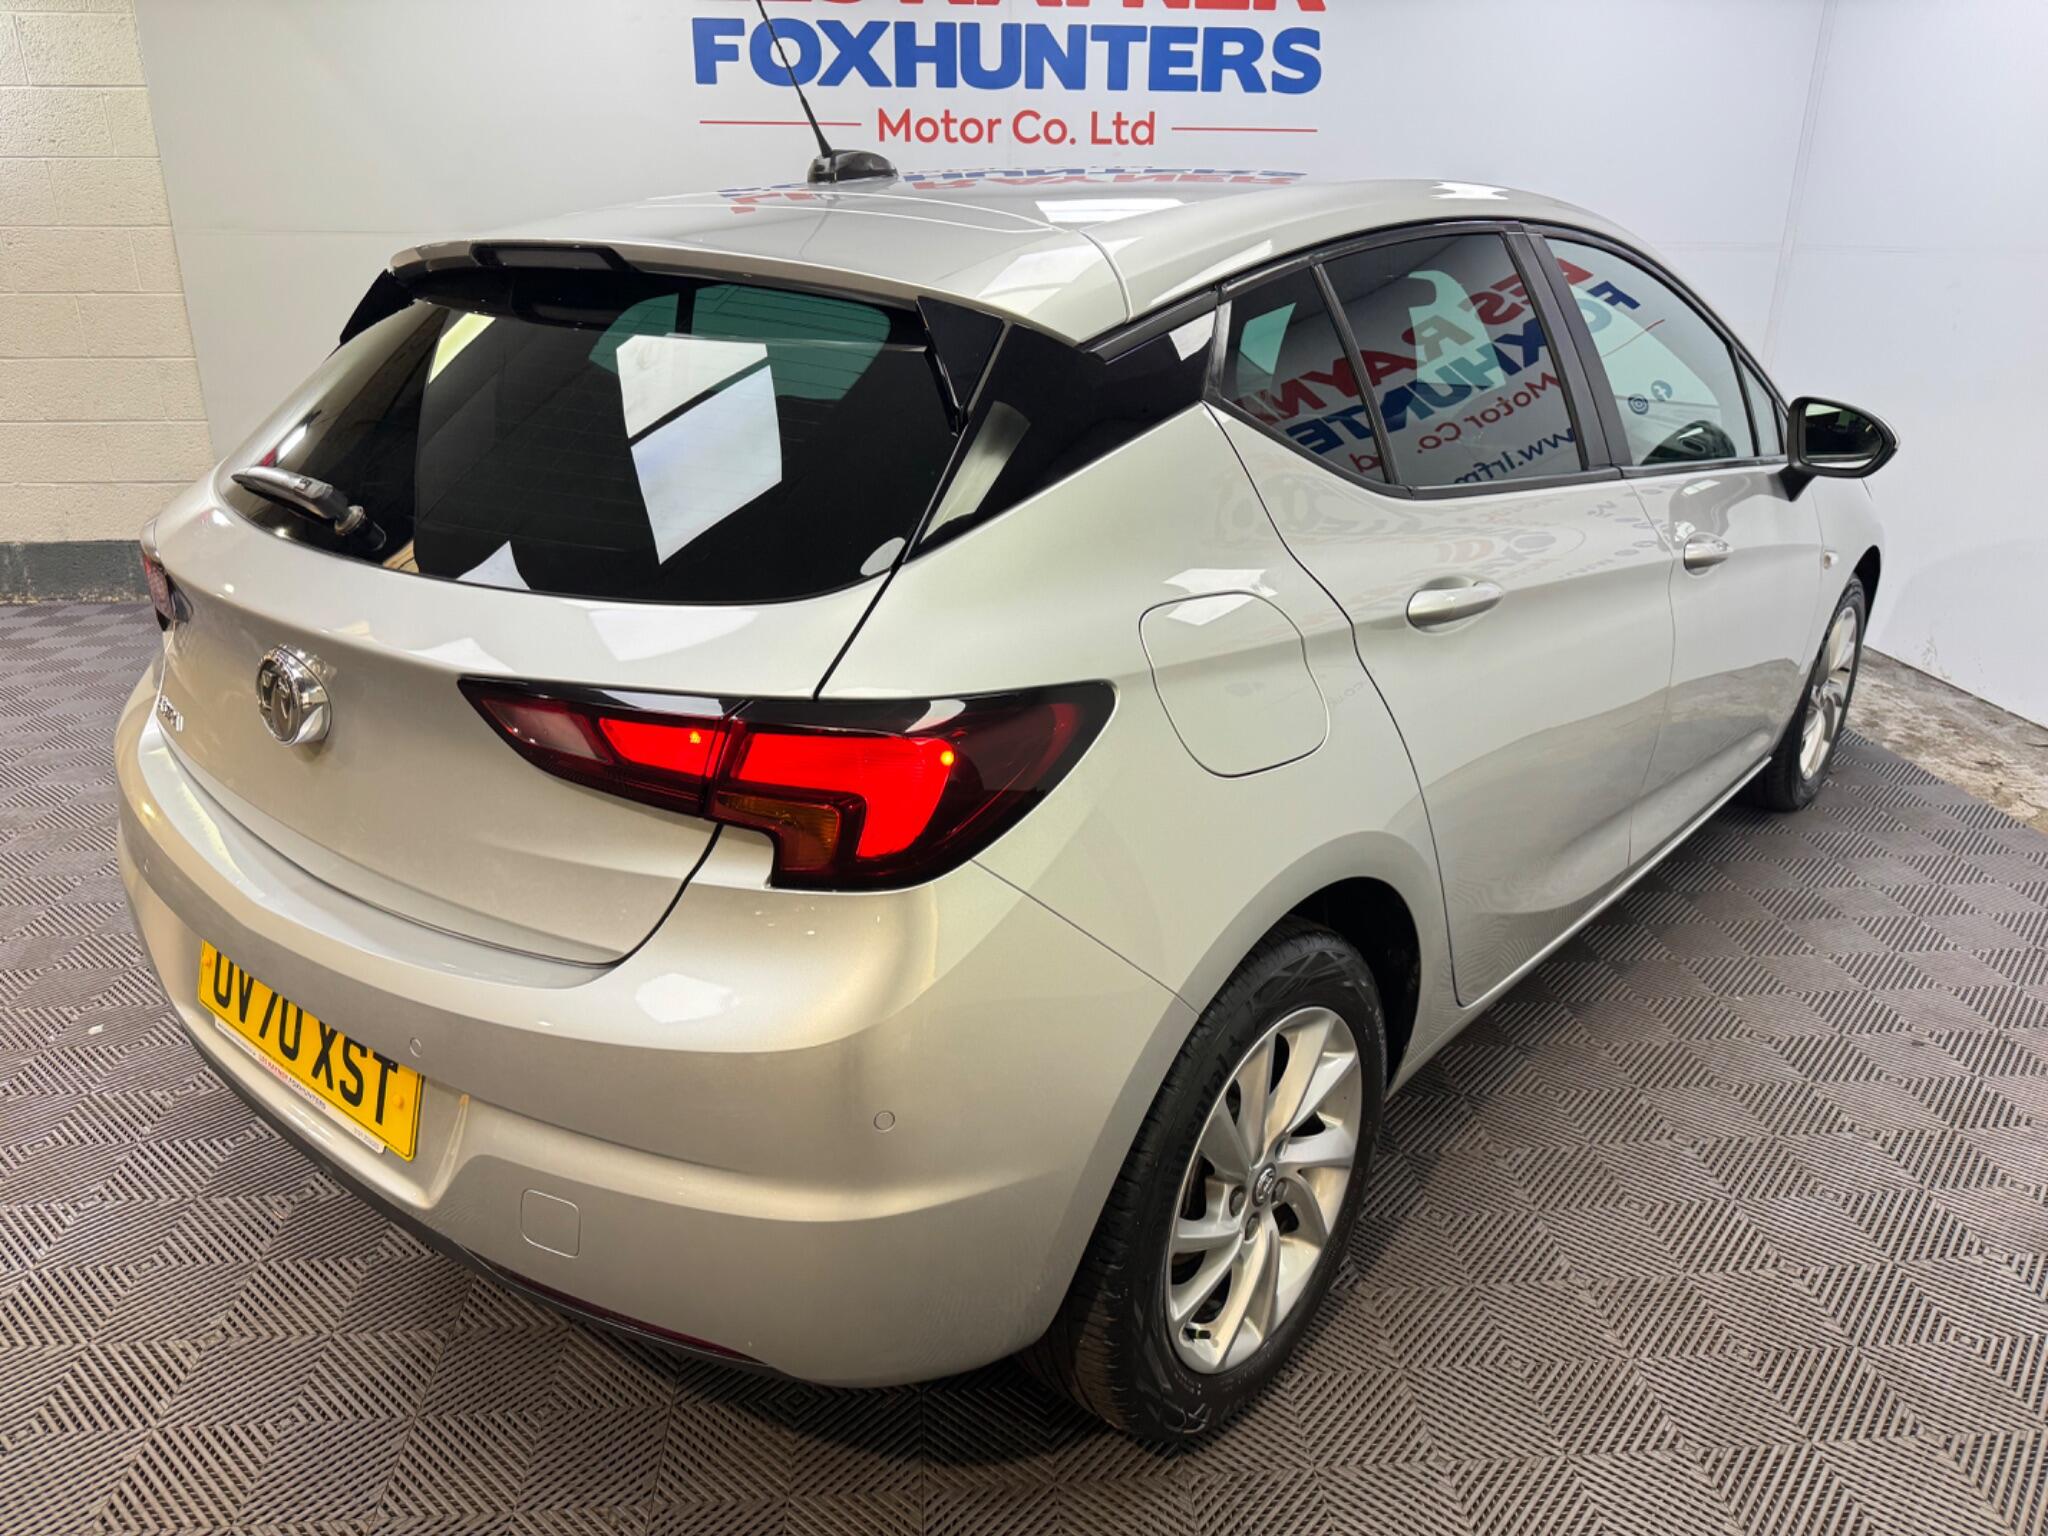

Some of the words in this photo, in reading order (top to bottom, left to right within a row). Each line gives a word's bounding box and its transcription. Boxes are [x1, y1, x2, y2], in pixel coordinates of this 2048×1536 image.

[692, 17, 1322, 94] FOXHUNTERS
[878, 108, 1001, 143] Motor
[1012, 109, 1076, 144] Co.
[1090, 111, 1155, 145] Ltd
[311, 1019, 399, 1126] XST
